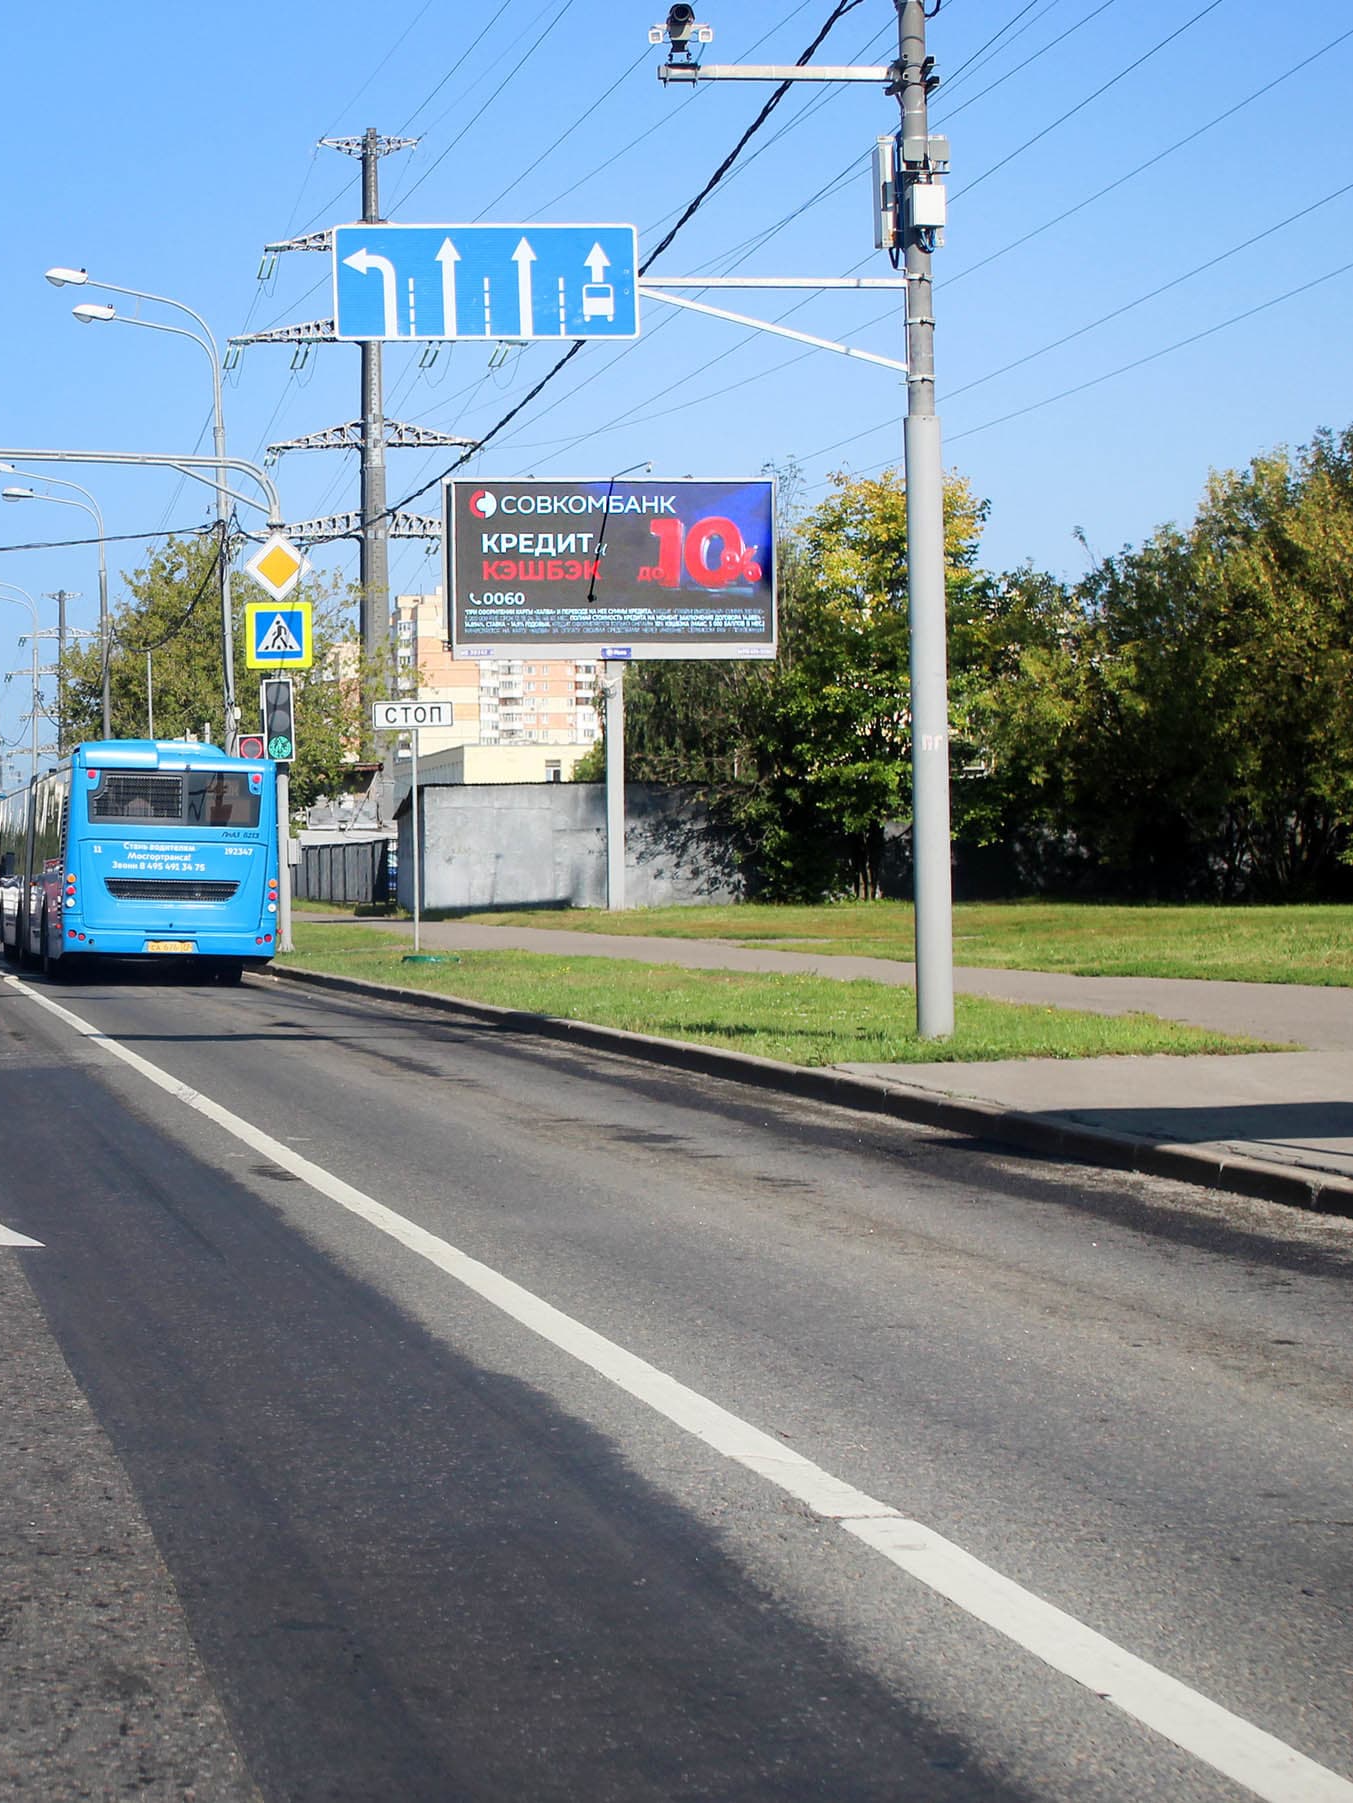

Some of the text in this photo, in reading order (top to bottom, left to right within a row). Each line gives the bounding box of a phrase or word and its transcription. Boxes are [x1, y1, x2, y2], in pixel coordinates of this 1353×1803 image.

[500, 495, 676, 515] СОВКОМБАНК
[481, 533, 593, 556] КРЕДИТ
[482, 560, 603, 580] КЭШБЭК
[482, 592, 526, 605] 0060
[385, 706, 442, 724] СТОП
[123, 841, 196, 852] Стань водителем
[112, 861, 138, 870] Звони
